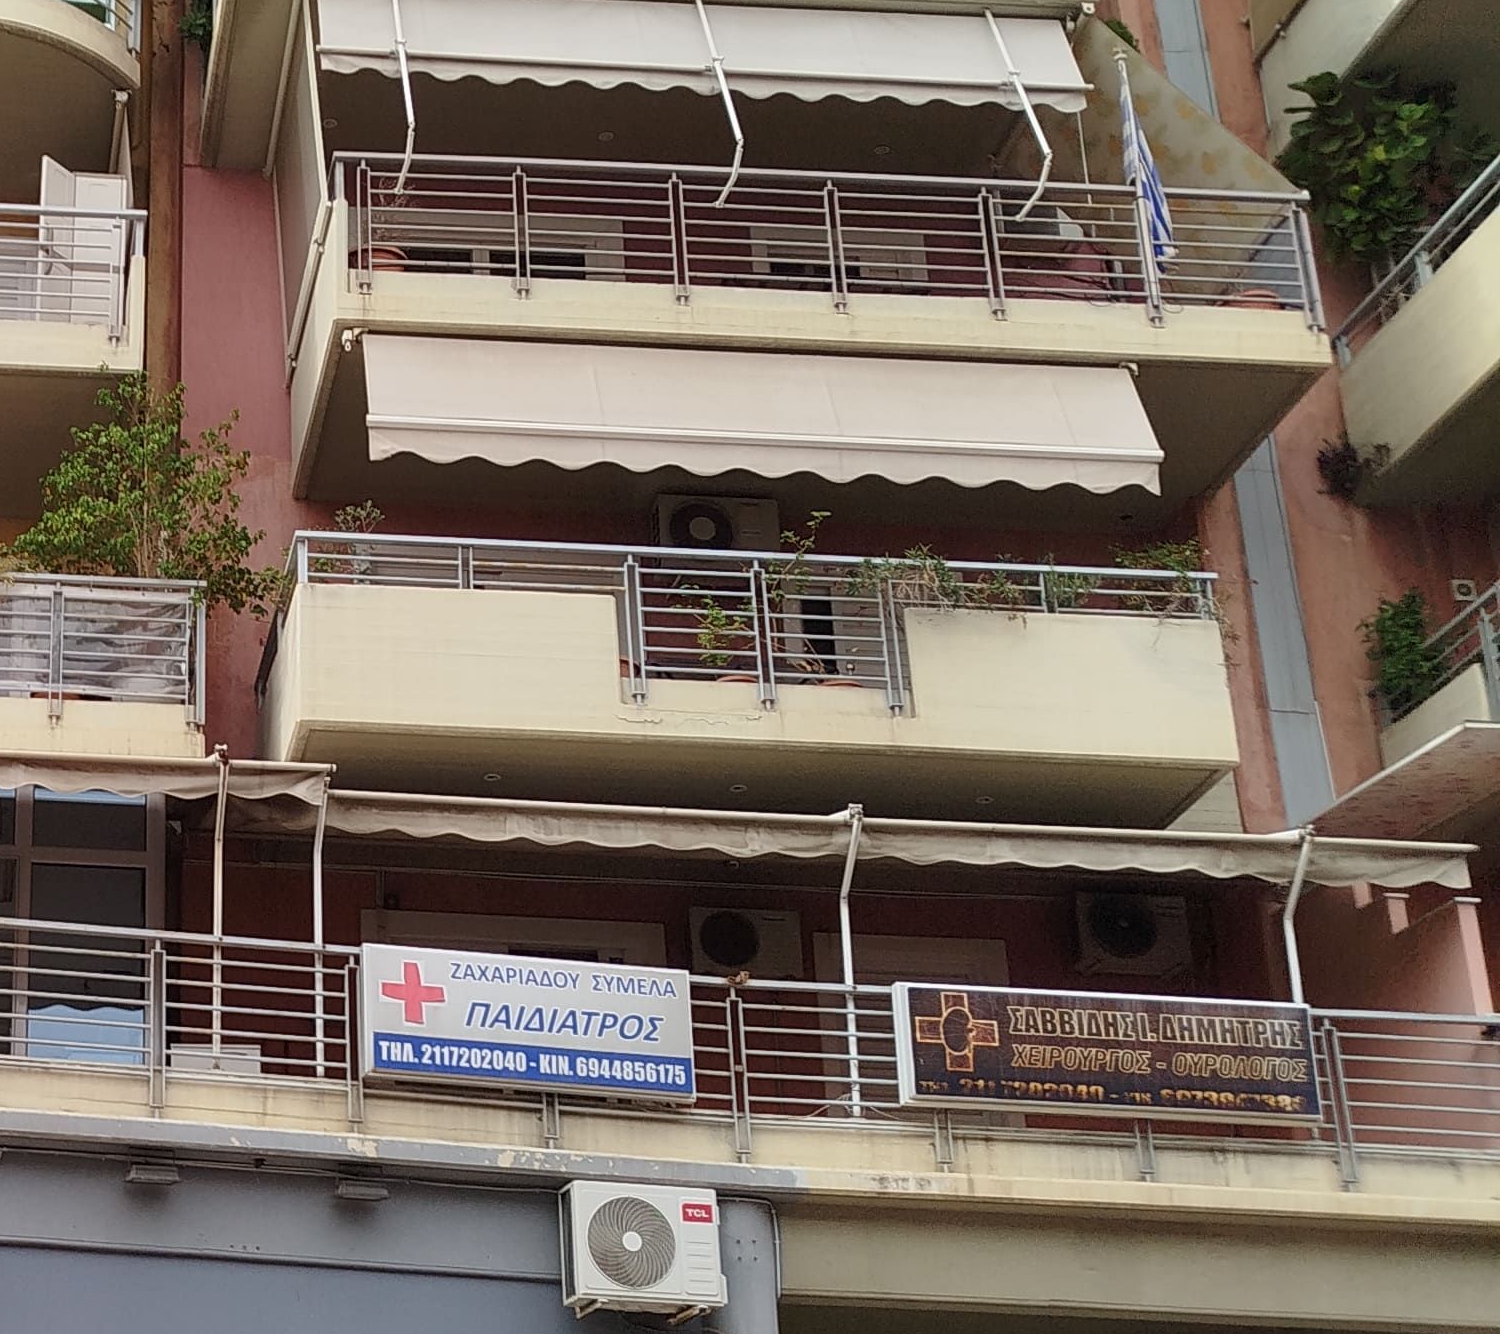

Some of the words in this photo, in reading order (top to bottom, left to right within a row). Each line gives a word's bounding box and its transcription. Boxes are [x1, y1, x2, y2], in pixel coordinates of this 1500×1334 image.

[450, 962, 580, 990] ΖΑΧΑΡΙΑΔΟΥ
[592, 974, 677, 998] ΣΥΜΕΛΑ
[465, 1002, 664, 1042] ΠΑΙΔΙΑΤΡΟΣ
[1007, 1005, 1135, 1041] ΣΑΒΒΙΔΗΣ
[1159, 1015, 1304, 1049] ΔΗΜΗΤΡΗΣ
[379, 1041, 419, 1064] ΤΗΛ.
[421, 1043, 527, 1072] 2117202040
[539, 1054, 574, 1076] ΚΙΝ.
[576, 1057, 686, 1085] 6944856175
[1011, 1044, 1151, 1074] ΧΕΙΡΟΥΡΓΟΣ
[1172, 1052, 1307, 1082] ΟΥΡΟΛΟΓΟΣ
[685, 1208, 709, 1218] TCL
